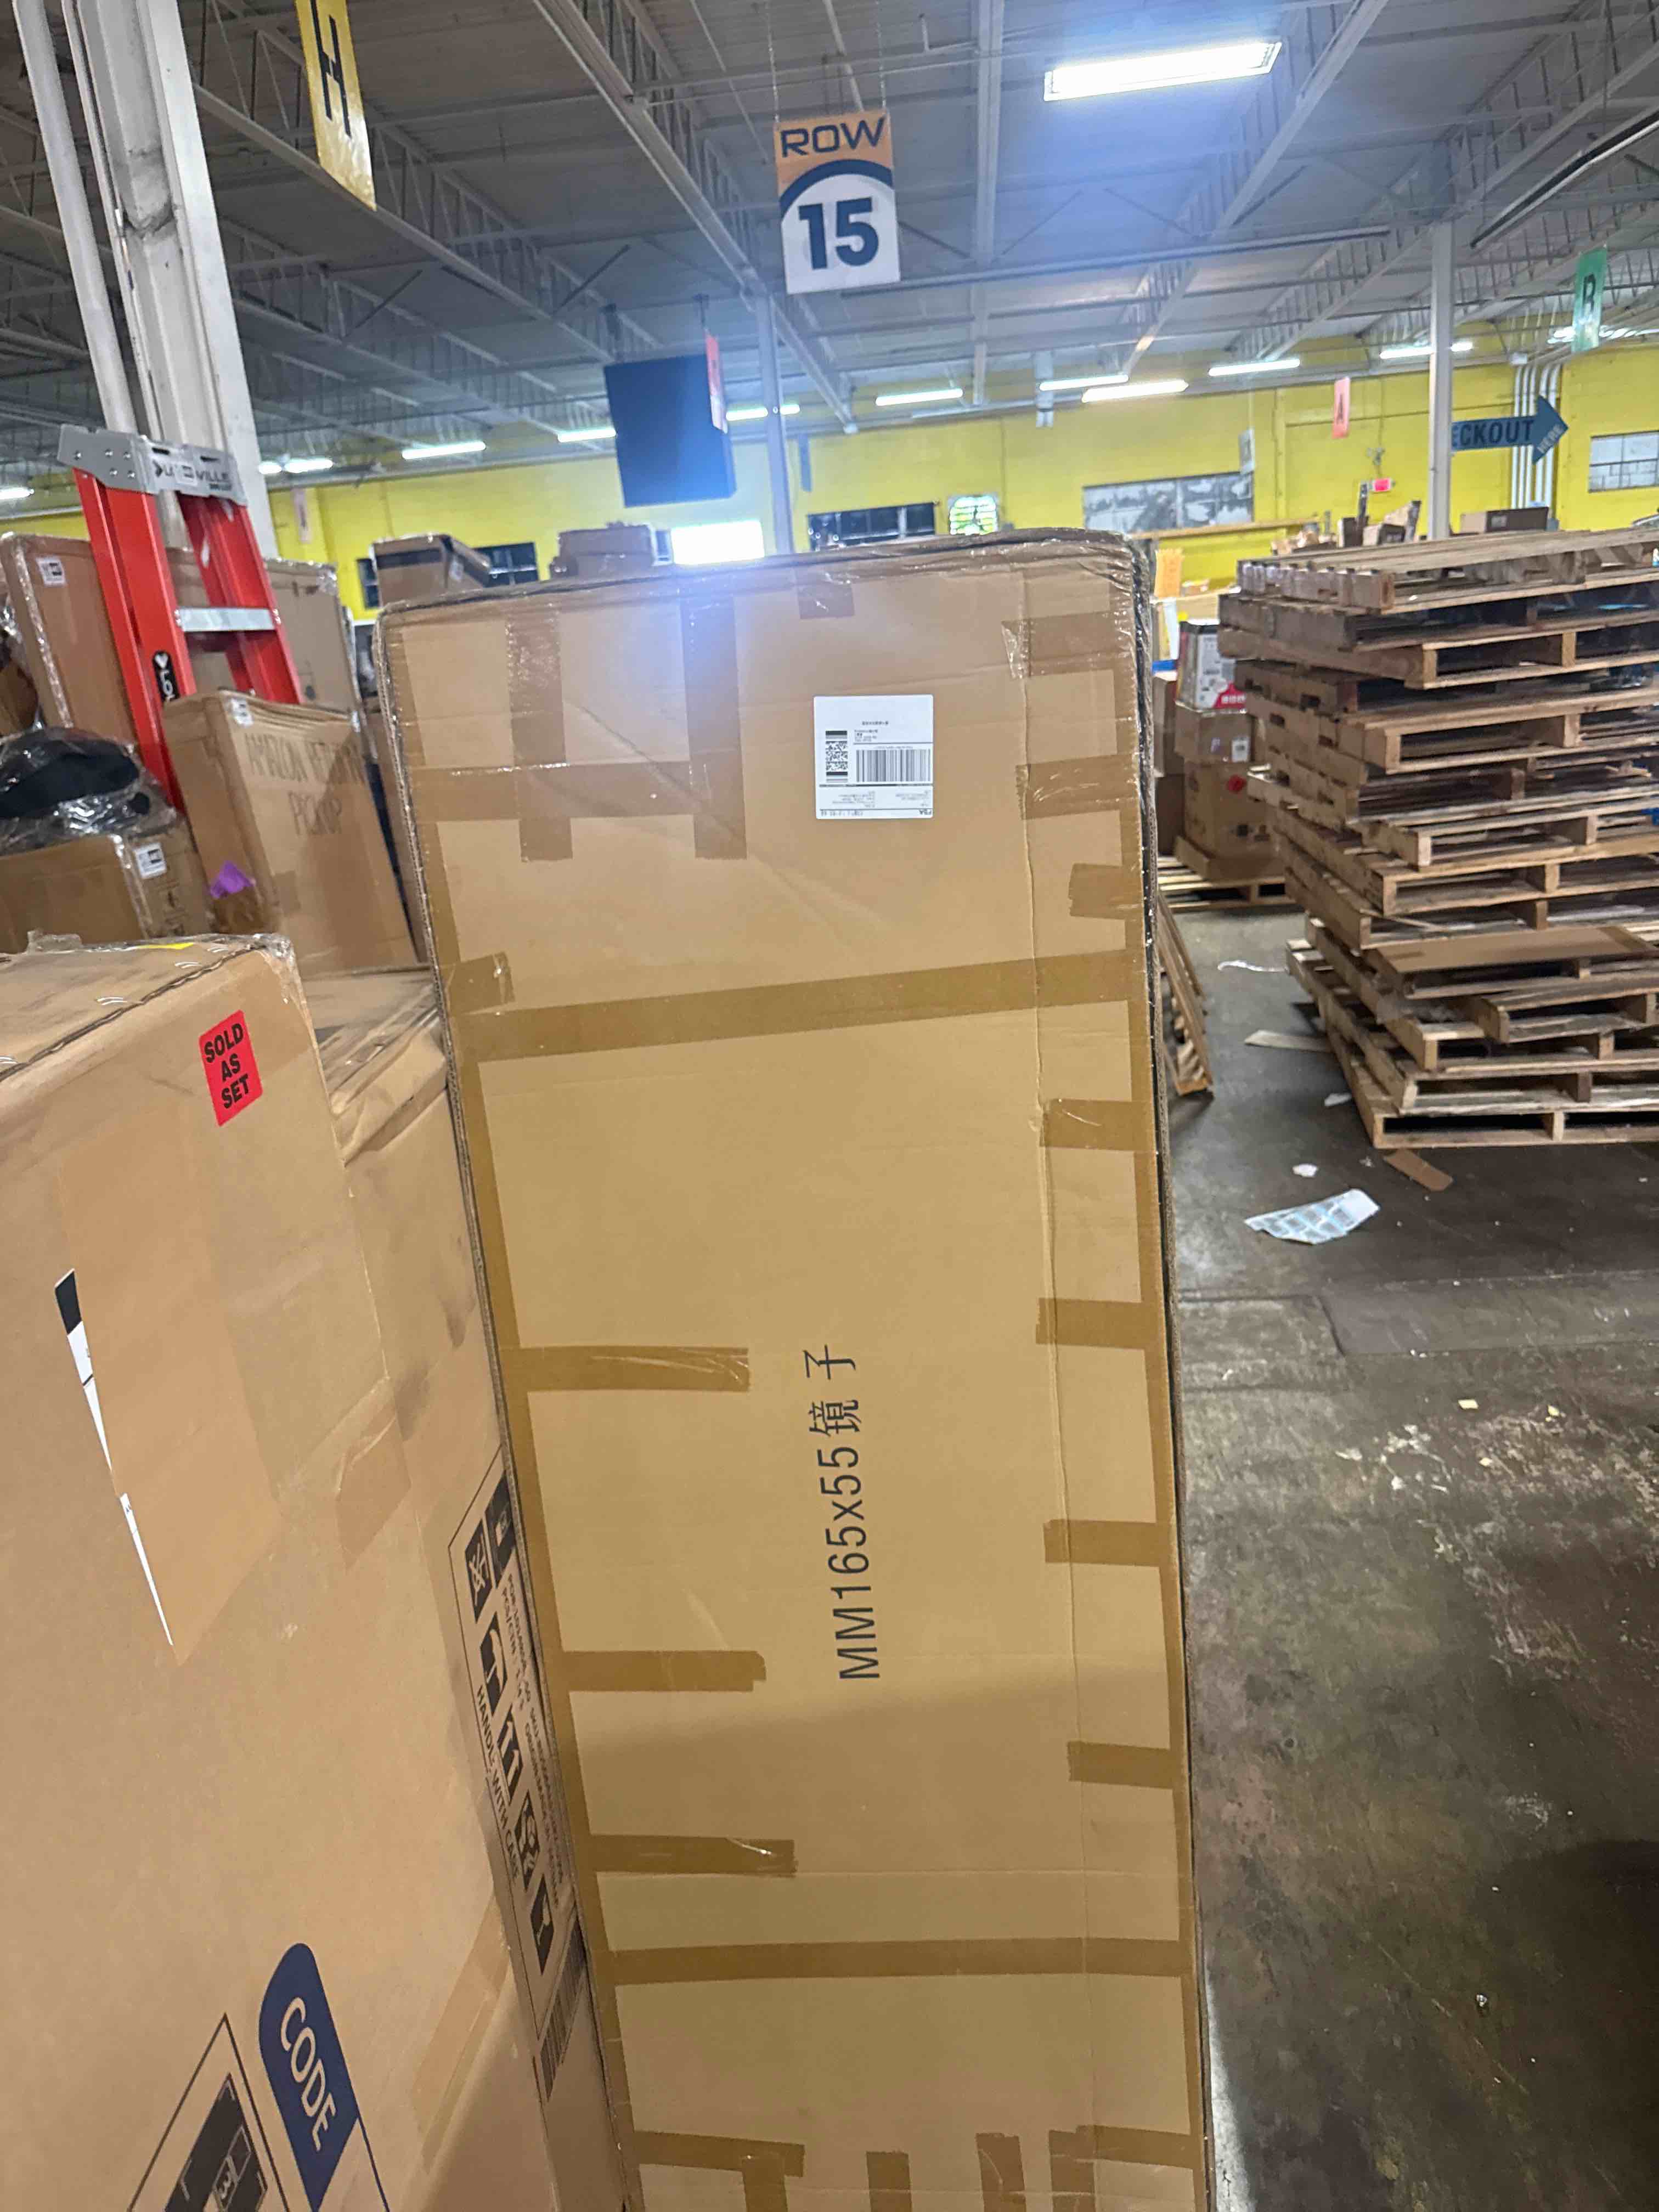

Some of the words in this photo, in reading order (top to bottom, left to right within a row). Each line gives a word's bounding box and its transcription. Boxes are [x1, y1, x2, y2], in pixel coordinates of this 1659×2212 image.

[310, 0, 352, 138] H
[780, 117, 884, 157] ROW
[798, 197, 879, 270] 15
[204, 1023, 244, 1063] SOLD
[221, 1053, 241, 1082] AS
[221, 1073, 250, 1109] SET
[477, 1685, 495, 1768] HANDL
[493, 1768, 509, 1830] WITH
[280, 1996, 336, 2152] CODE
